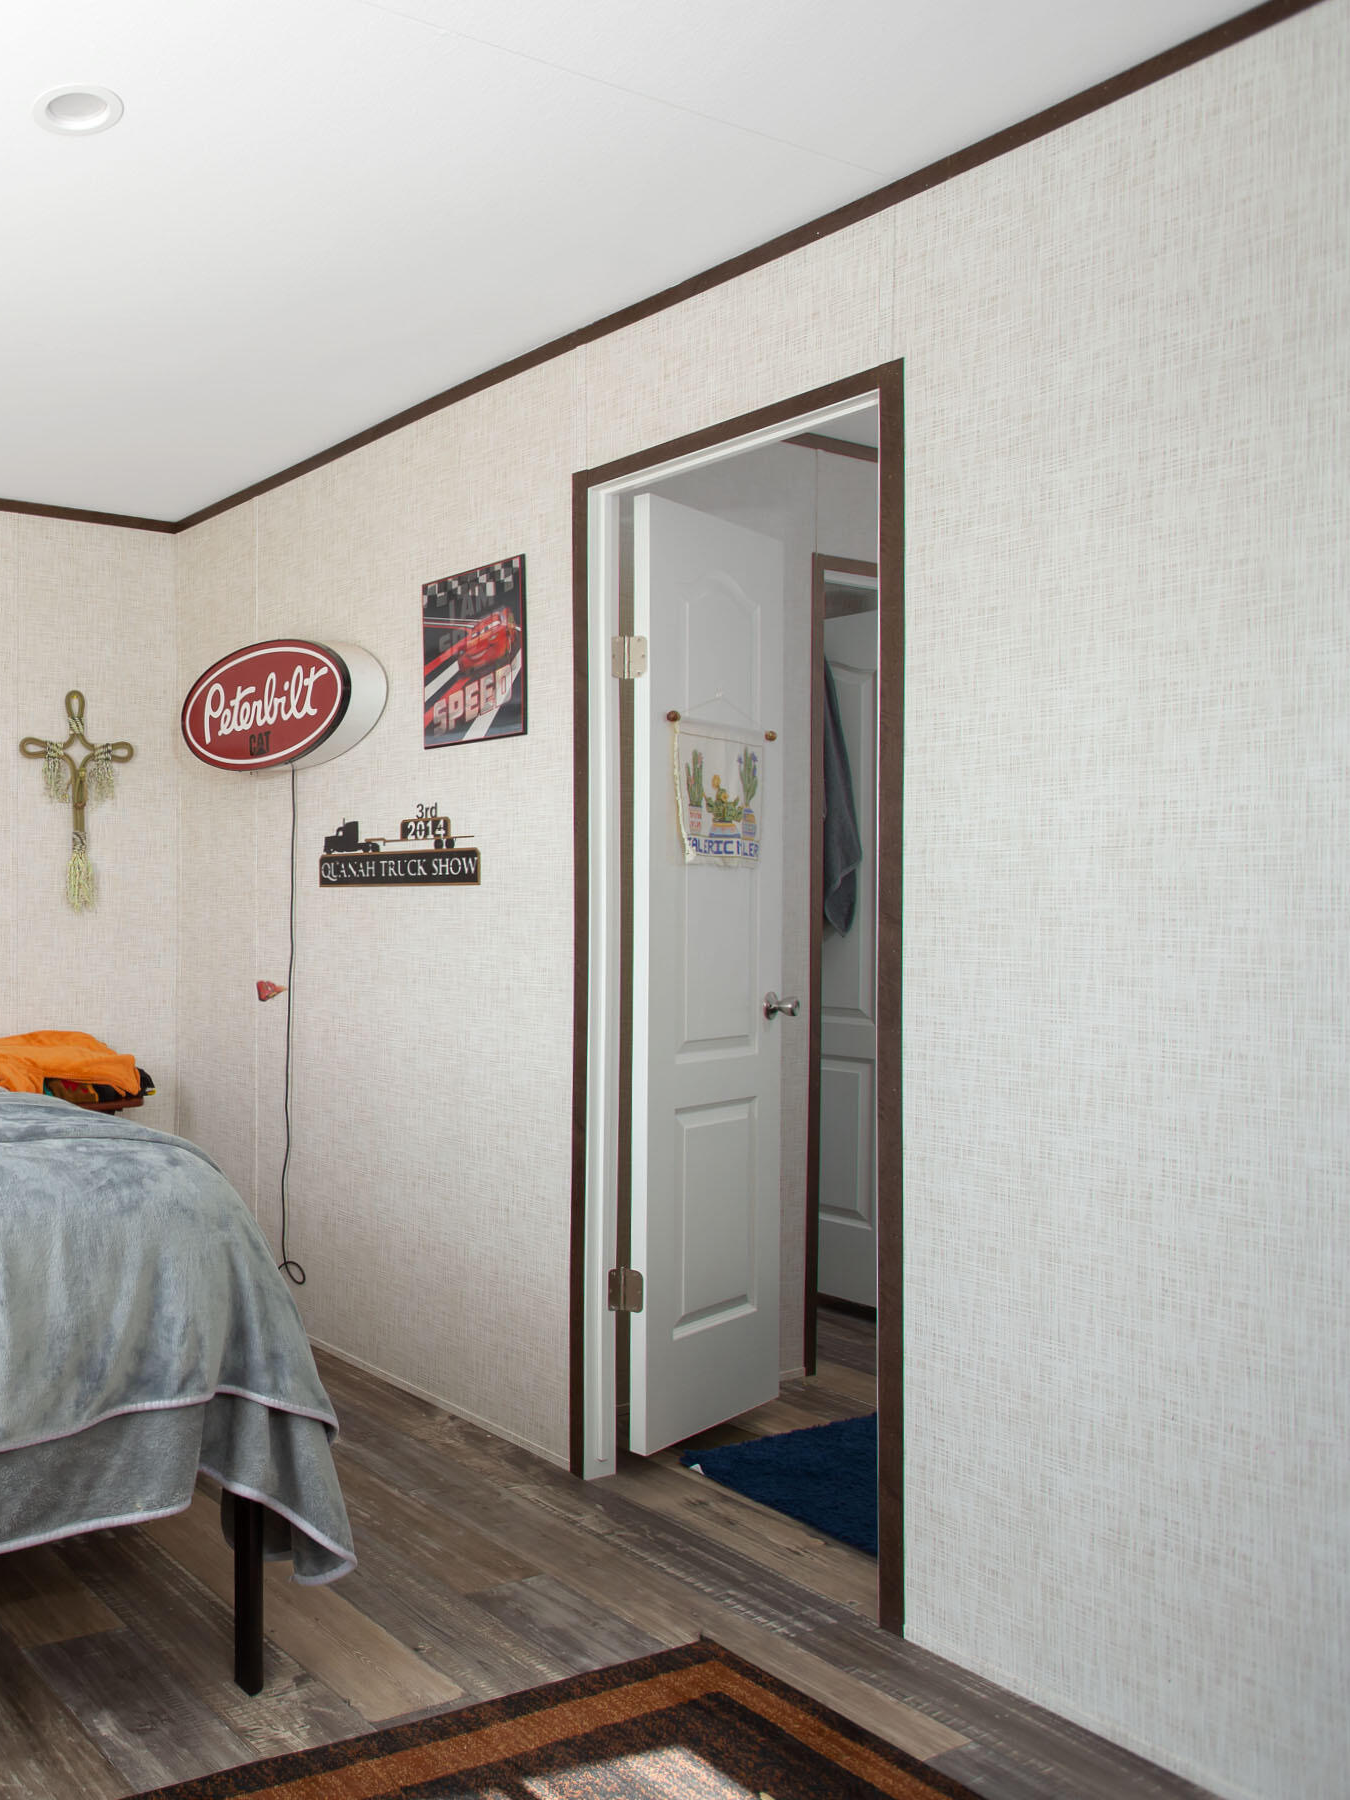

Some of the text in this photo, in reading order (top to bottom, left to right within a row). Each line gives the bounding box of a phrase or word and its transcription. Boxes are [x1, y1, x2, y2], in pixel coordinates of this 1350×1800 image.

[204, 665, 329, 744] Peterbilt
[433, 664, 513, 738] SPEED
[249, 731, 271, 756] CAT
[416, 802, 438, 819] 3rd
[407, 819, 446, 840] 2014
[321, 856, 479, 882] QUANAH TRUCK SHOW
